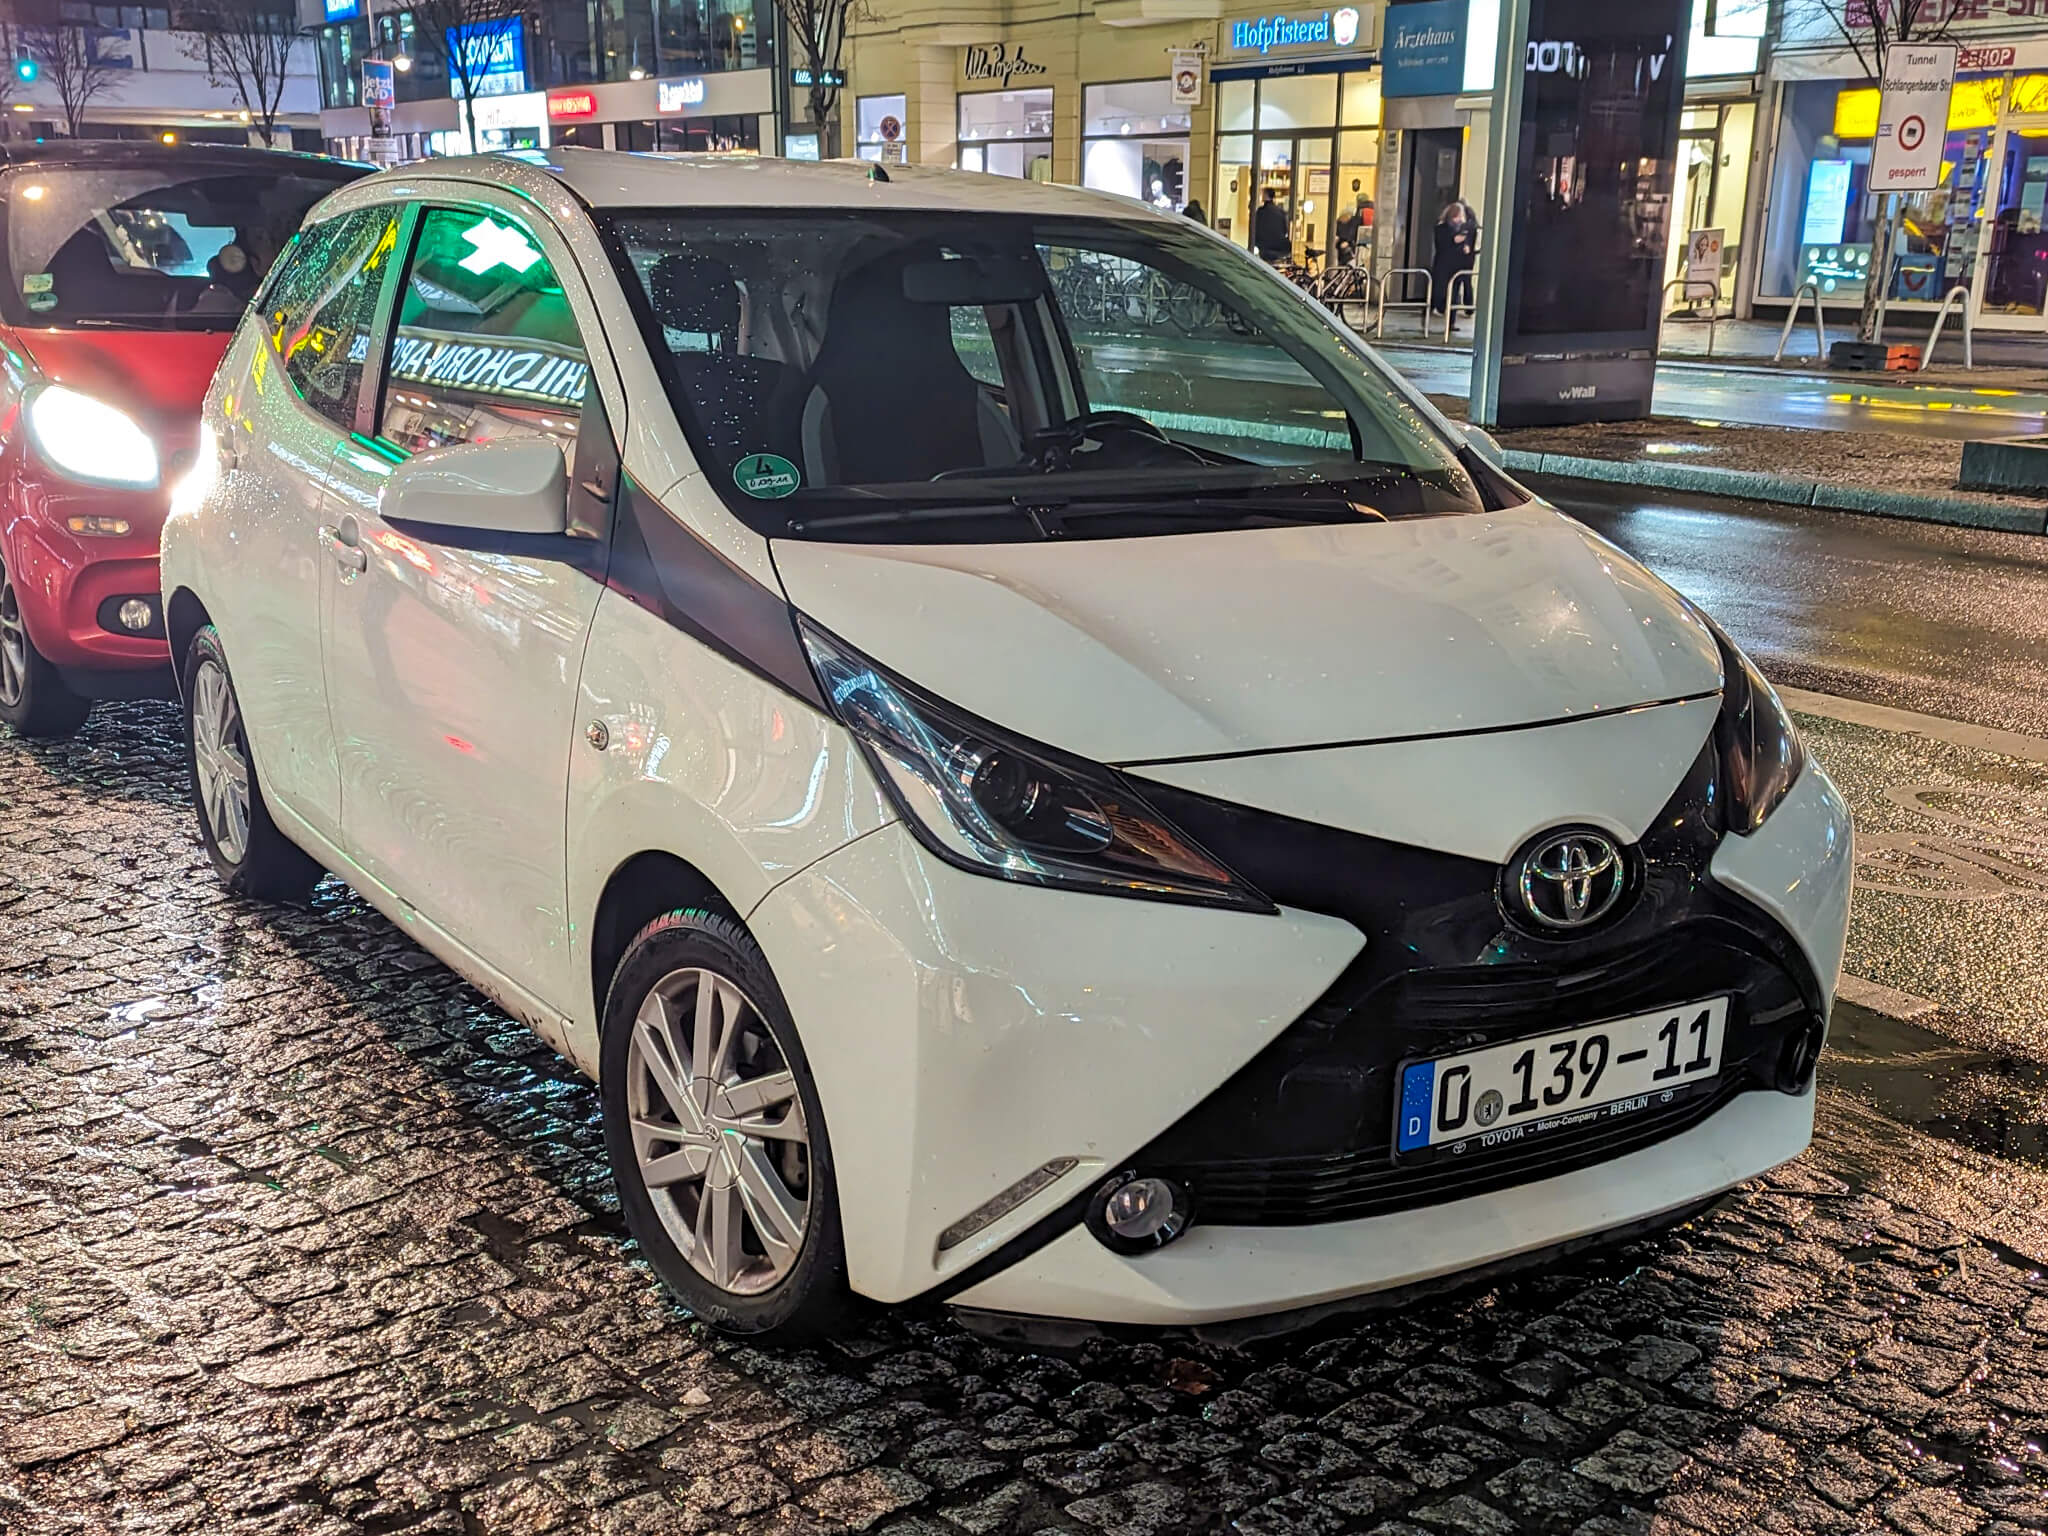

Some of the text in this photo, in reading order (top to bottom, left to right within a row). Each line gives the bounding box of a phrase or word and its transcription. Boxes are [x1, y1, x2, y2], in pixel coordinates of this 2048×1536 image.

[1233, 13, 1329, 54] Hofpfisterei
[1394, 25, 1456, 49] Ärztehaus
[965, 43, 1047, 87] Ulla Popken
[1907, 54, 1937, 65] Tunnel
[364, 76, 392, 88] Jetzt
[1884, 80, 1938, 94] Schlangenbader
[365, 88, 389, 100] AfD
[1888, 167, 1926, 180] gesperrt
[756, 457, 774, 476] 4
[1507, 1009, 1712, 1116] 139-11
[1408, 1116, 1421, 1136] D
[1480, 1127, 1525, 1147] TOYOTA
[1537, 1110, 1599, 1132] Motor-Company
[1610, 1096, 1649, 1117] BERLIN
